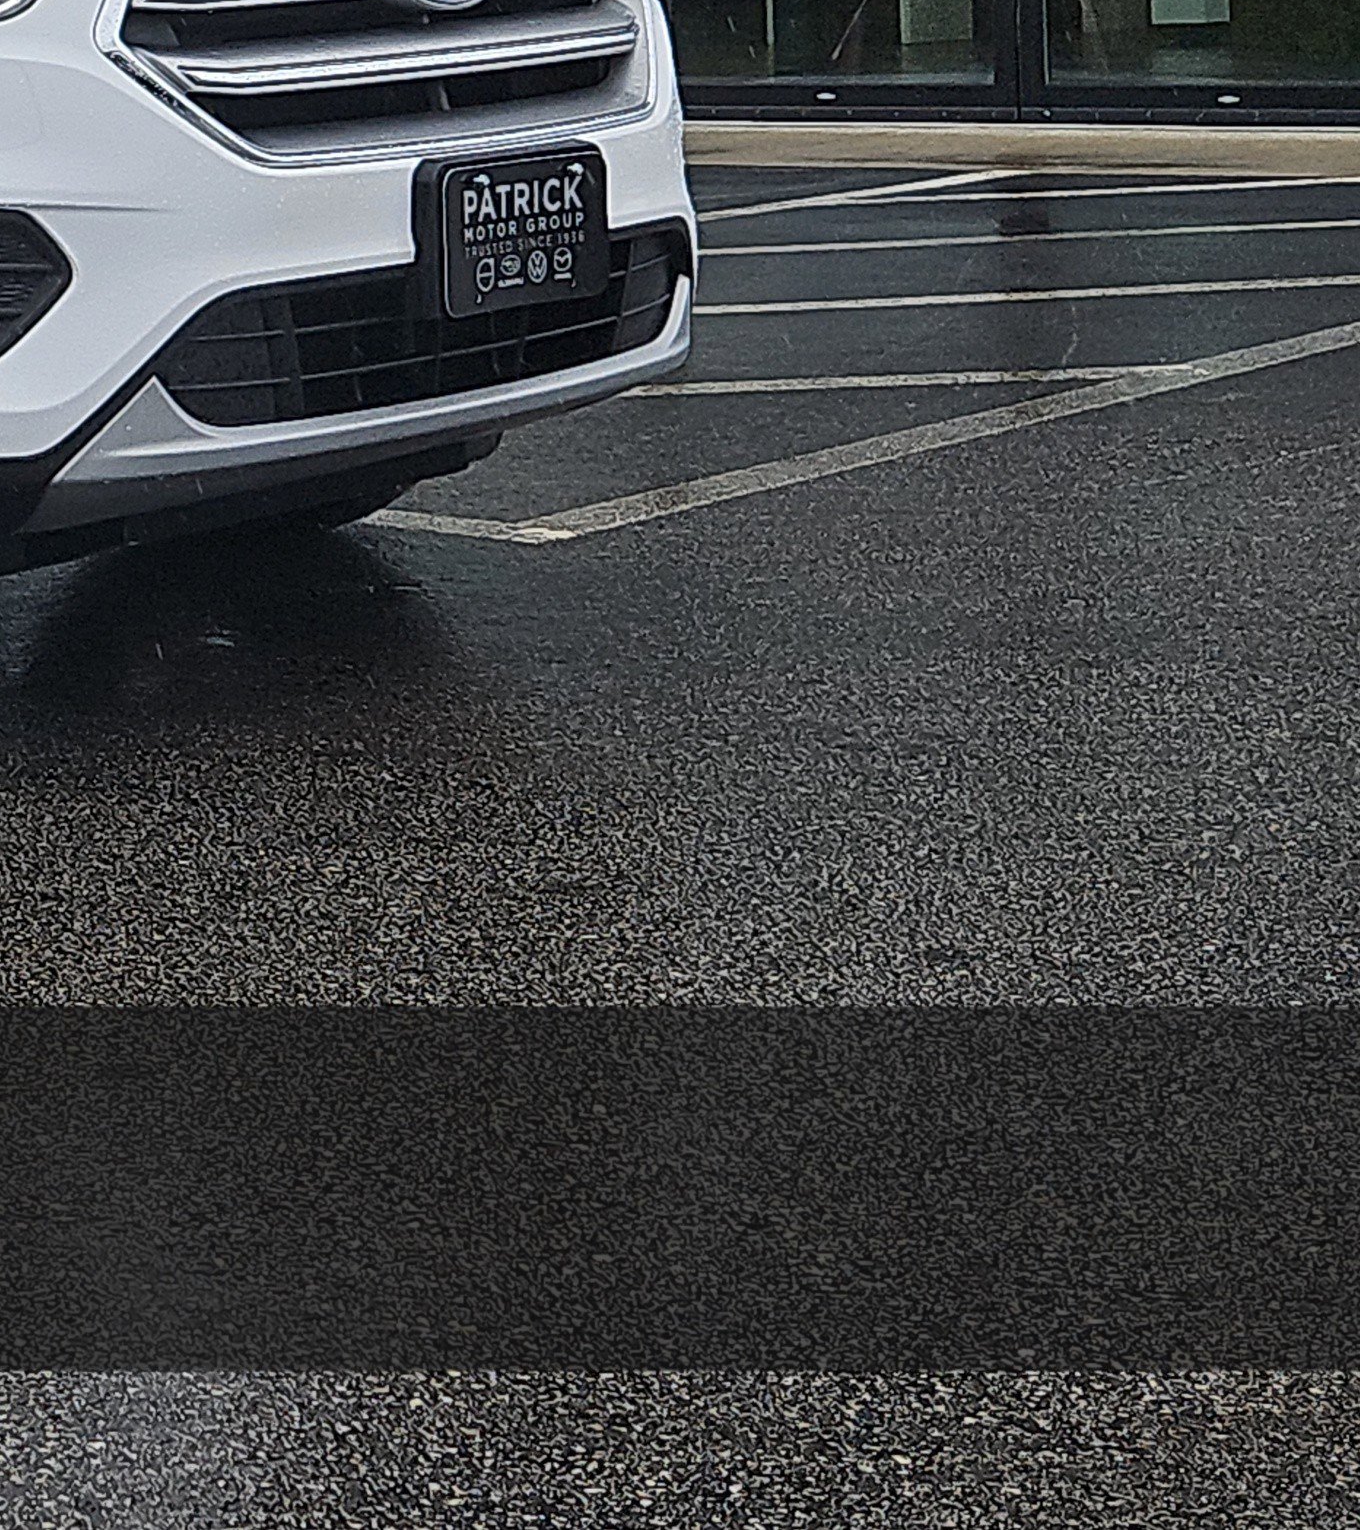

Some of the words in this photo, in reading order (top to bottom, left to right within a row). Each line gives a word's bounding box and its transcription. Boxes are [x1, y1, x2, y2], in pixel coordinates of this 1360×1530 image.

[463, 175, 584, 225] PATRICK
[464, 221, 517, 244] MOTOR
[526, 212, 585, 232] GROUP
[518, 234, 554, 251] SINCE
